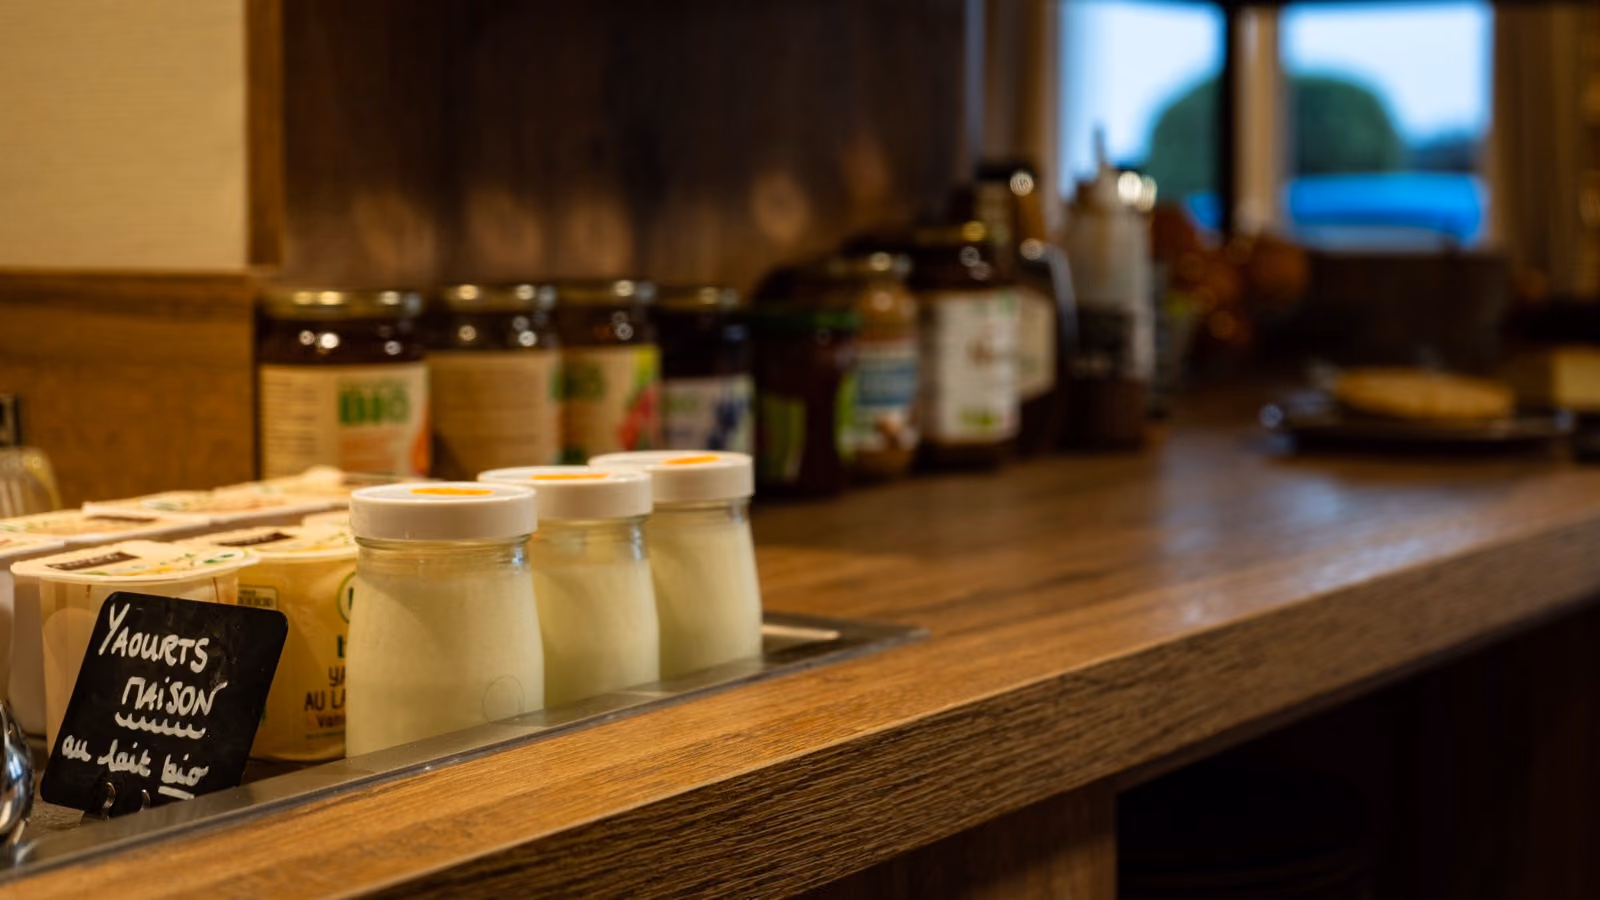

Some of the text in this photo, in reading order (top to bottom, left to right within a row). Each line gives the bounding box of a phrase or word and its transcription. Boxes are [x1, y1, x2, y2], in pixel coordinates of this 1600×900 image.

[99, 602, 210, 673] YAOURTS
[304, 689, 326, 712] AU
[62, 735, 209, 786] au lait bio
